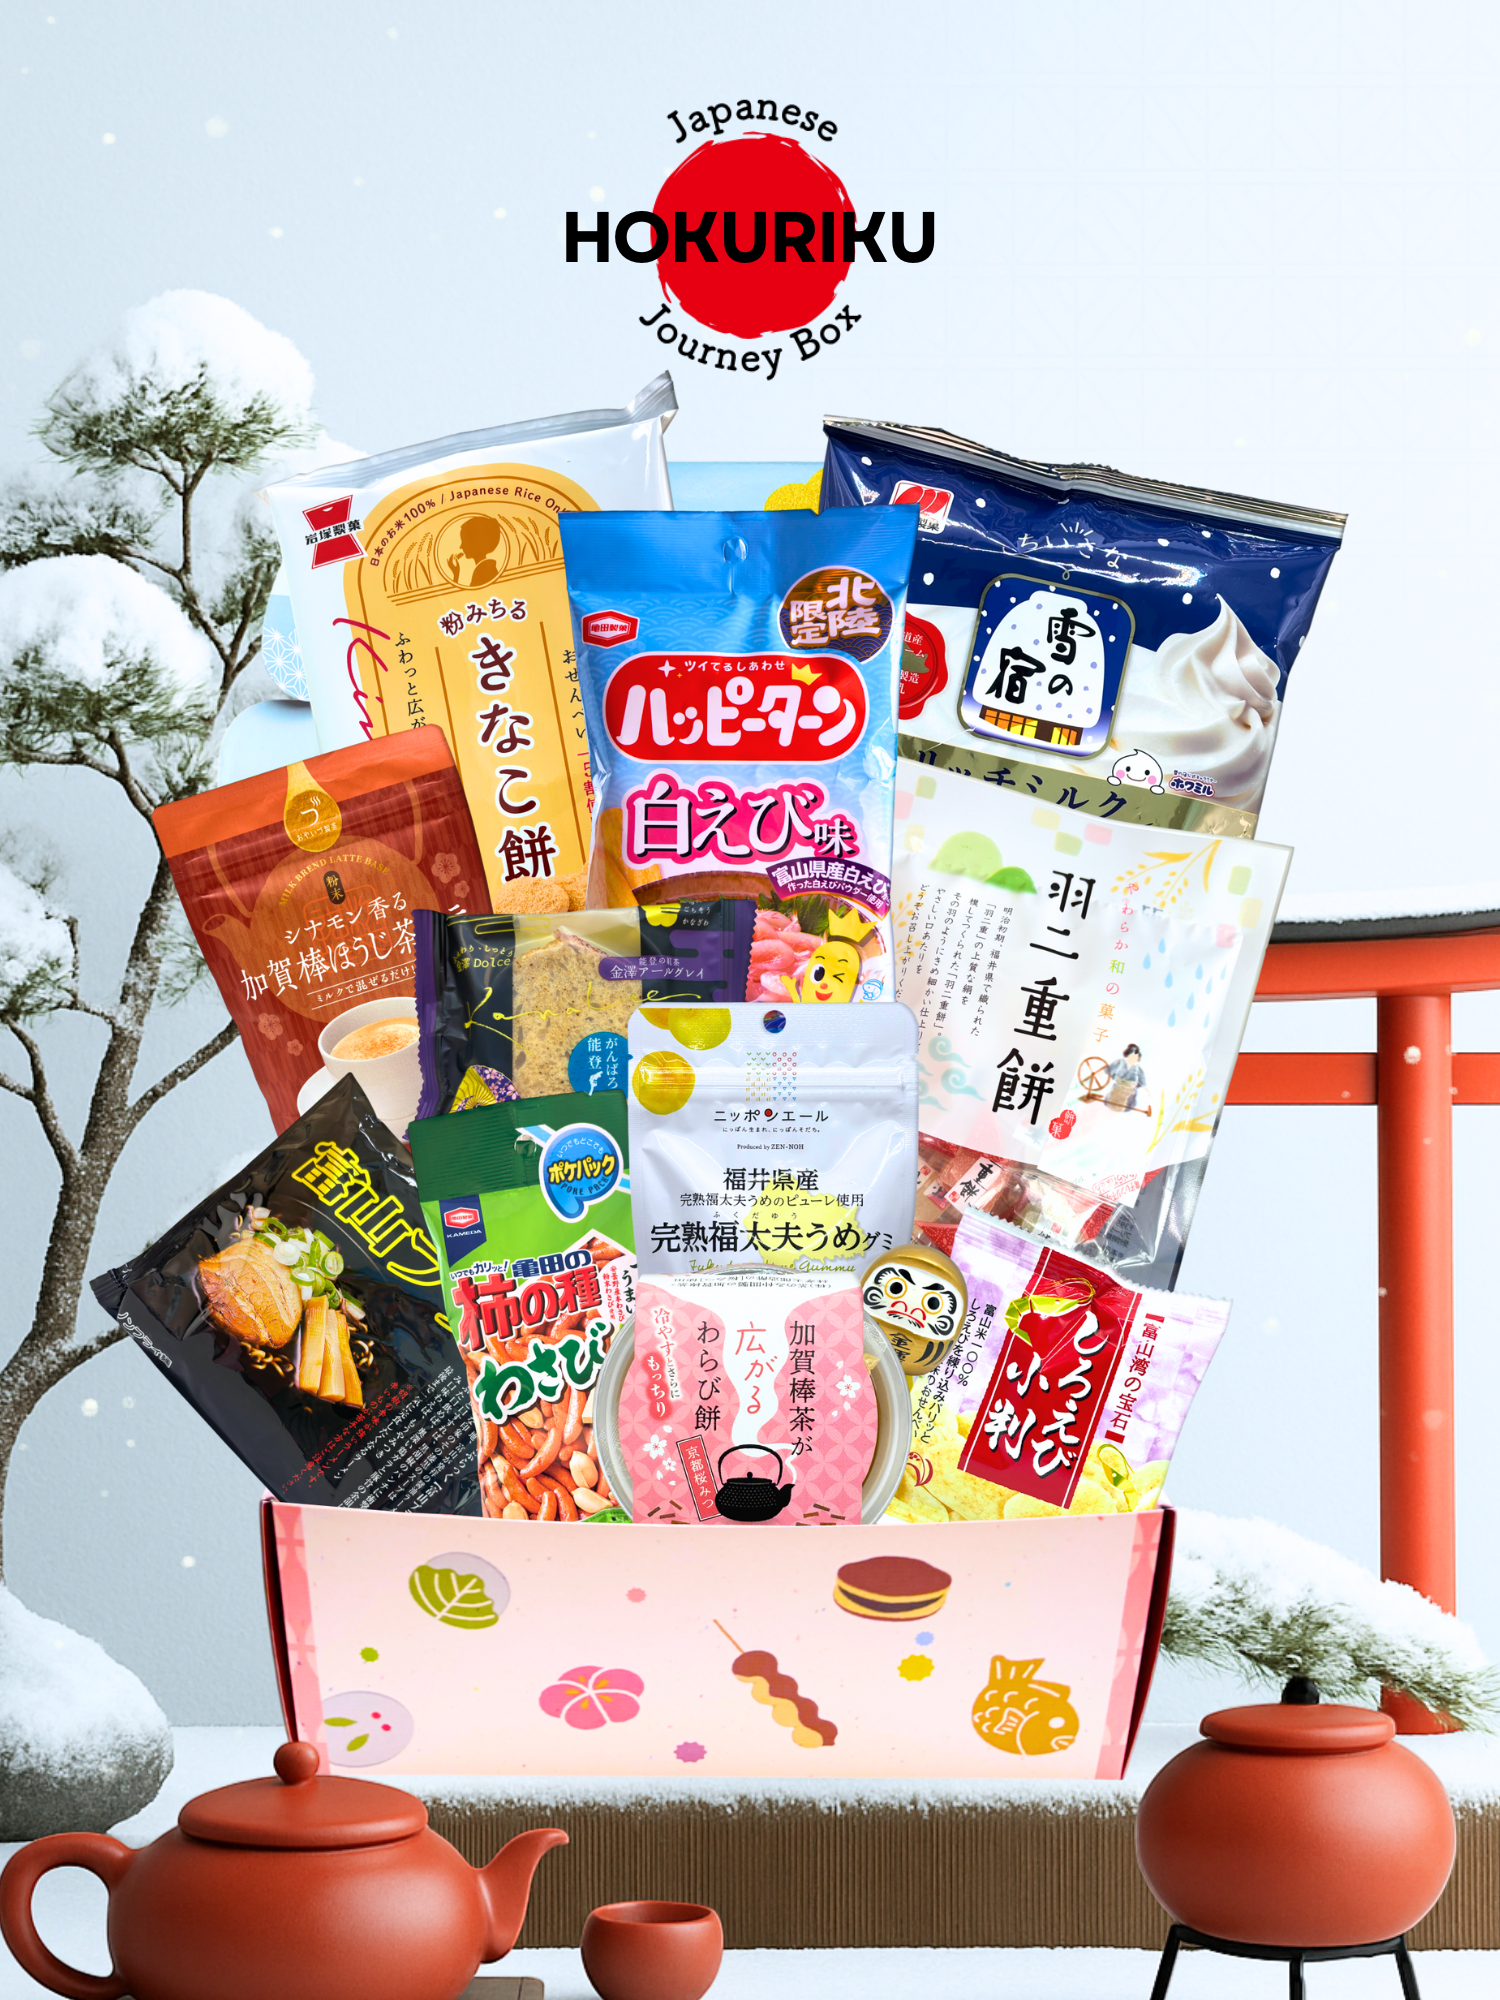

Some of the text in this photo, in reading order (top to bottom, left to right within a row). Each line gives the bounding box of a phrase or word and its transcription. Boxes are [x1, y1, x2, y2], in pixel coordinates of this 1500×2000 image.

[449, 486, 509, 502] Japanese
[514, 486, 541, 503] Rice
[440, 600, 527, 636] 粉みちる
[790, 600, 831, 647] 限定
[826, 576, 881, 638] 北陸
[684, 660, 786, 672] ツイてるしあわせ
[616, 676, 857, 747] ハッピーターン
[472, 637, 557, 882] きなこ餅
[1170, 777, 1214, 796] ホワミル
[279, 854, 390, 907] MILK BREND LATTE BASE
[326, 875, 344, 901] 粉末
[284, 892, 407, 945] シナモン香る
[916, 888, 946, 975] やさしい口あたりを
[240, 918, 417, 1001] 加賀棒ほうじ茶
[473, 957, 511, 969] Dolce
[610, 963, 704, 980] 金澤アールグレイ
[639, 957, 681, 967] 能登の紅茶
[918, 892, 962, 1046] その羽のようにきめ細かい仕上り
[961, 902, 997, 1006] 「羽二重」の上質な絹を
[970, 907, 1013, 1037] 明治初期、福井県で織られた
[1092, 882, 1140, 1043] やわらか和の菓子
[991, 870, 1096, 1126] 羽二重餅
[587, 1037, 602, 1070] 能登
[549, 1154, 615, 1184] ポケパック
[556, 1137, 605, 1158] いつでもどこでも
[763, 1143, 770, 1151] by
[680, 1193, 865, 1208] 完熟福太夫うめのピューレ使用
[722, 1168, 820, 1192] 福井県産
[447, 1229, 482, 1239] KAMEDA
[650, 1221, 894, 1255] 完熟福太夫うめグミ
[713, 1211, 799, 1220] ふくだゆう
[452, 1267, 602, 1350] 柿の種
[475, 1323, 607, 1420] わさび
[653, 1307, 681, 1399] 冷やすとさらに
[694, 1320, 721, 1432] わらび餅
[735, 1321, 778, 1414] 広がる
[1104, 1312, 1166, 1445] 【富山湾の宝石】
[647, 1356, 667, 1418] もっちり
[789, 1320, 816, 1457] 加賀棒茶が
[982, 1350, 1050, 1462] 小判
[1030, 1310, 1110, 1479] しろえび
[685, 1446, 714, 1509] 京都桜みつ
